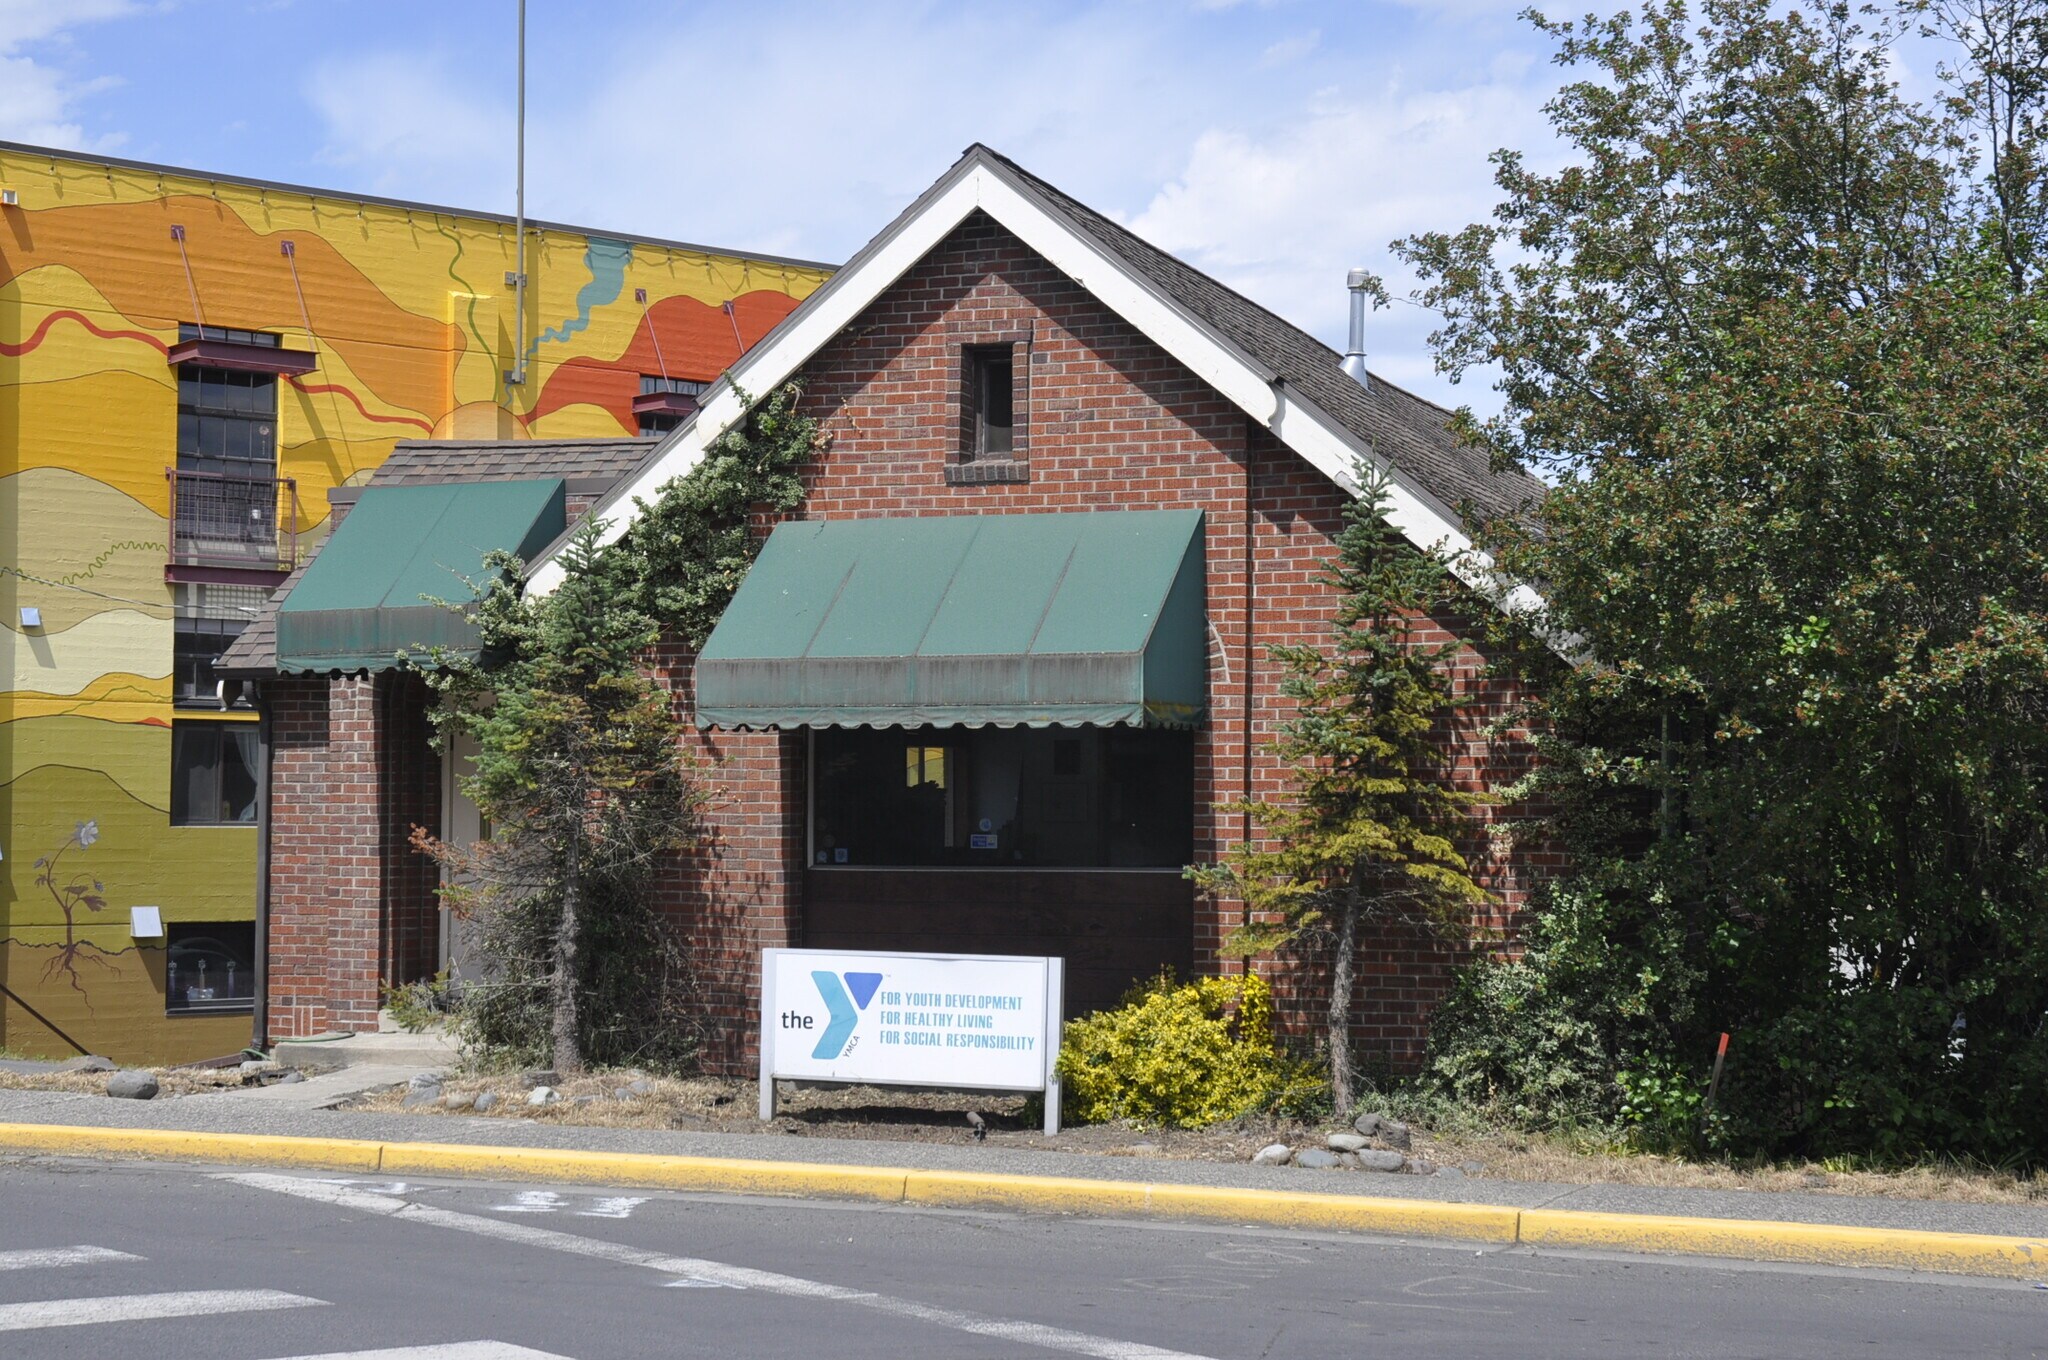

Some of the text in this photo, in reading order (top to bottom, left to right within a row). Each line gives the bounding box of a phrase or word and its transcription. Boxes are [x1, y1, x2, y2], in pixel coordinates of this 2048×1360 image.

[881, 992, 1022, 1010] FOR YOUTH DEVELOPMENT
[781, 1010, 813, 1030] the
[881, 1011, 993, 1029] FOR HEALTHY LIVING
[843, 1035, 860, 1058] YMCA
[880, 1031, 1035, 1050] FOR SOCIAL RESPONSIBILITY
